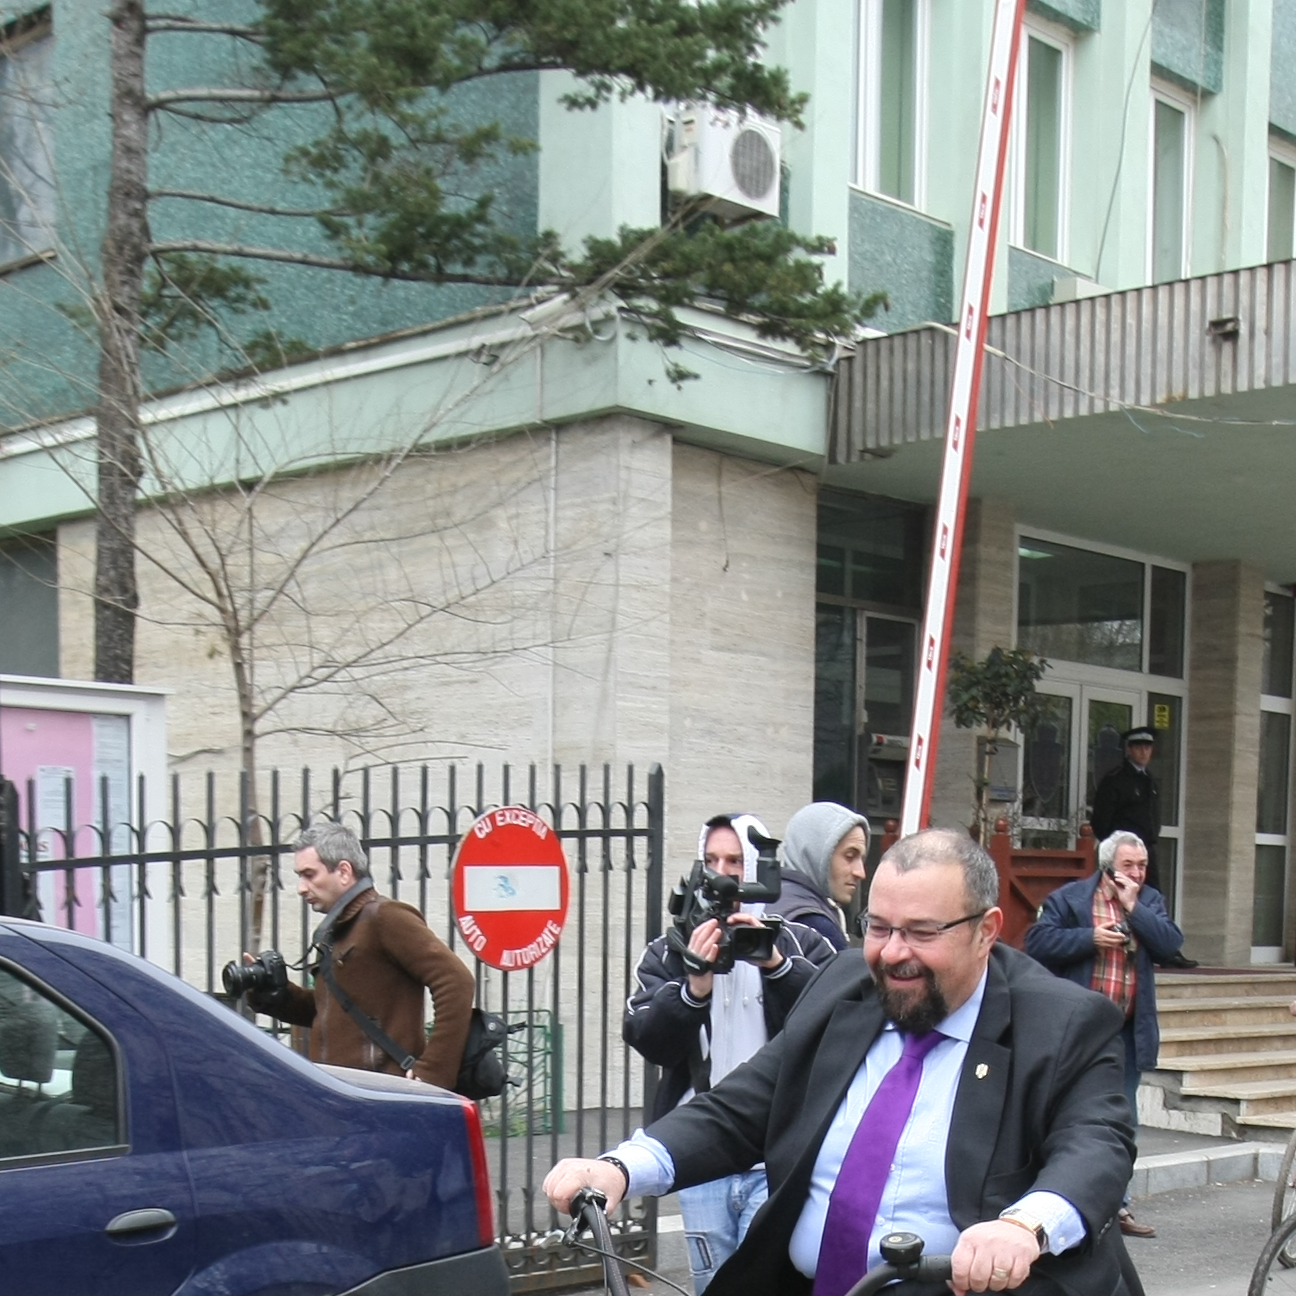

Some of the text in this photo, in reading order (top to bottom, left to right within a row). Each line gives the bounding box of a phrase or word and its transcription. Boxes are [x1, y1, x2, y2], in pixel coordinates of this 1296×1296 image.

[473, 818, 493, 840] CU
[458, 914, 562, 968] AUTO AUTORIZATE
